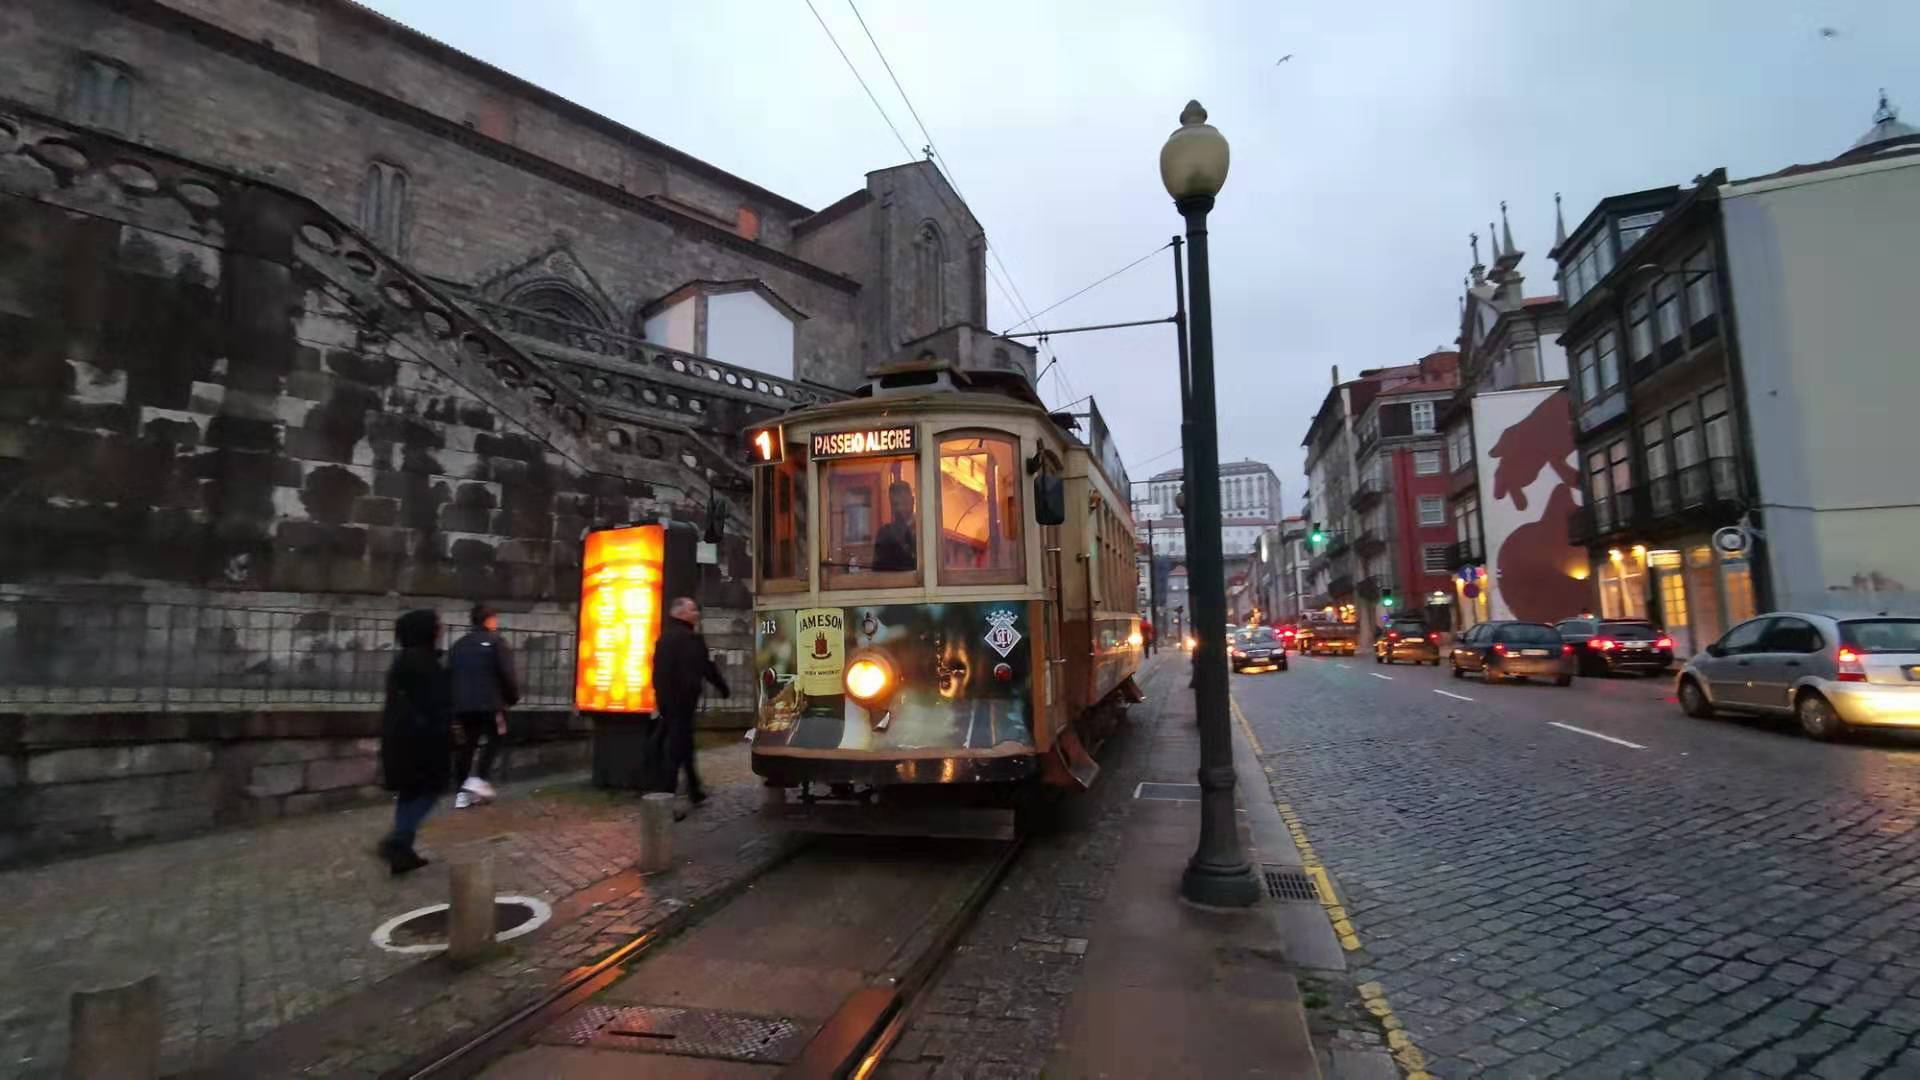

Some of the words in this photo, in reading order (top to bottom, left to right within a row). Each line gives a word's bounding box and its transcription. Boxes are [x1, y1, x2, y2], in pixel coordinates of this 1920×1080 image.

[755, 430, 771, 460] 1
[814, 433, 865, 455] PASSEIO
[865, 429, 911, 452] ALEGRE
[761, 620, 776, 634] 213
[800, 614, 843, 632] JAMESON
